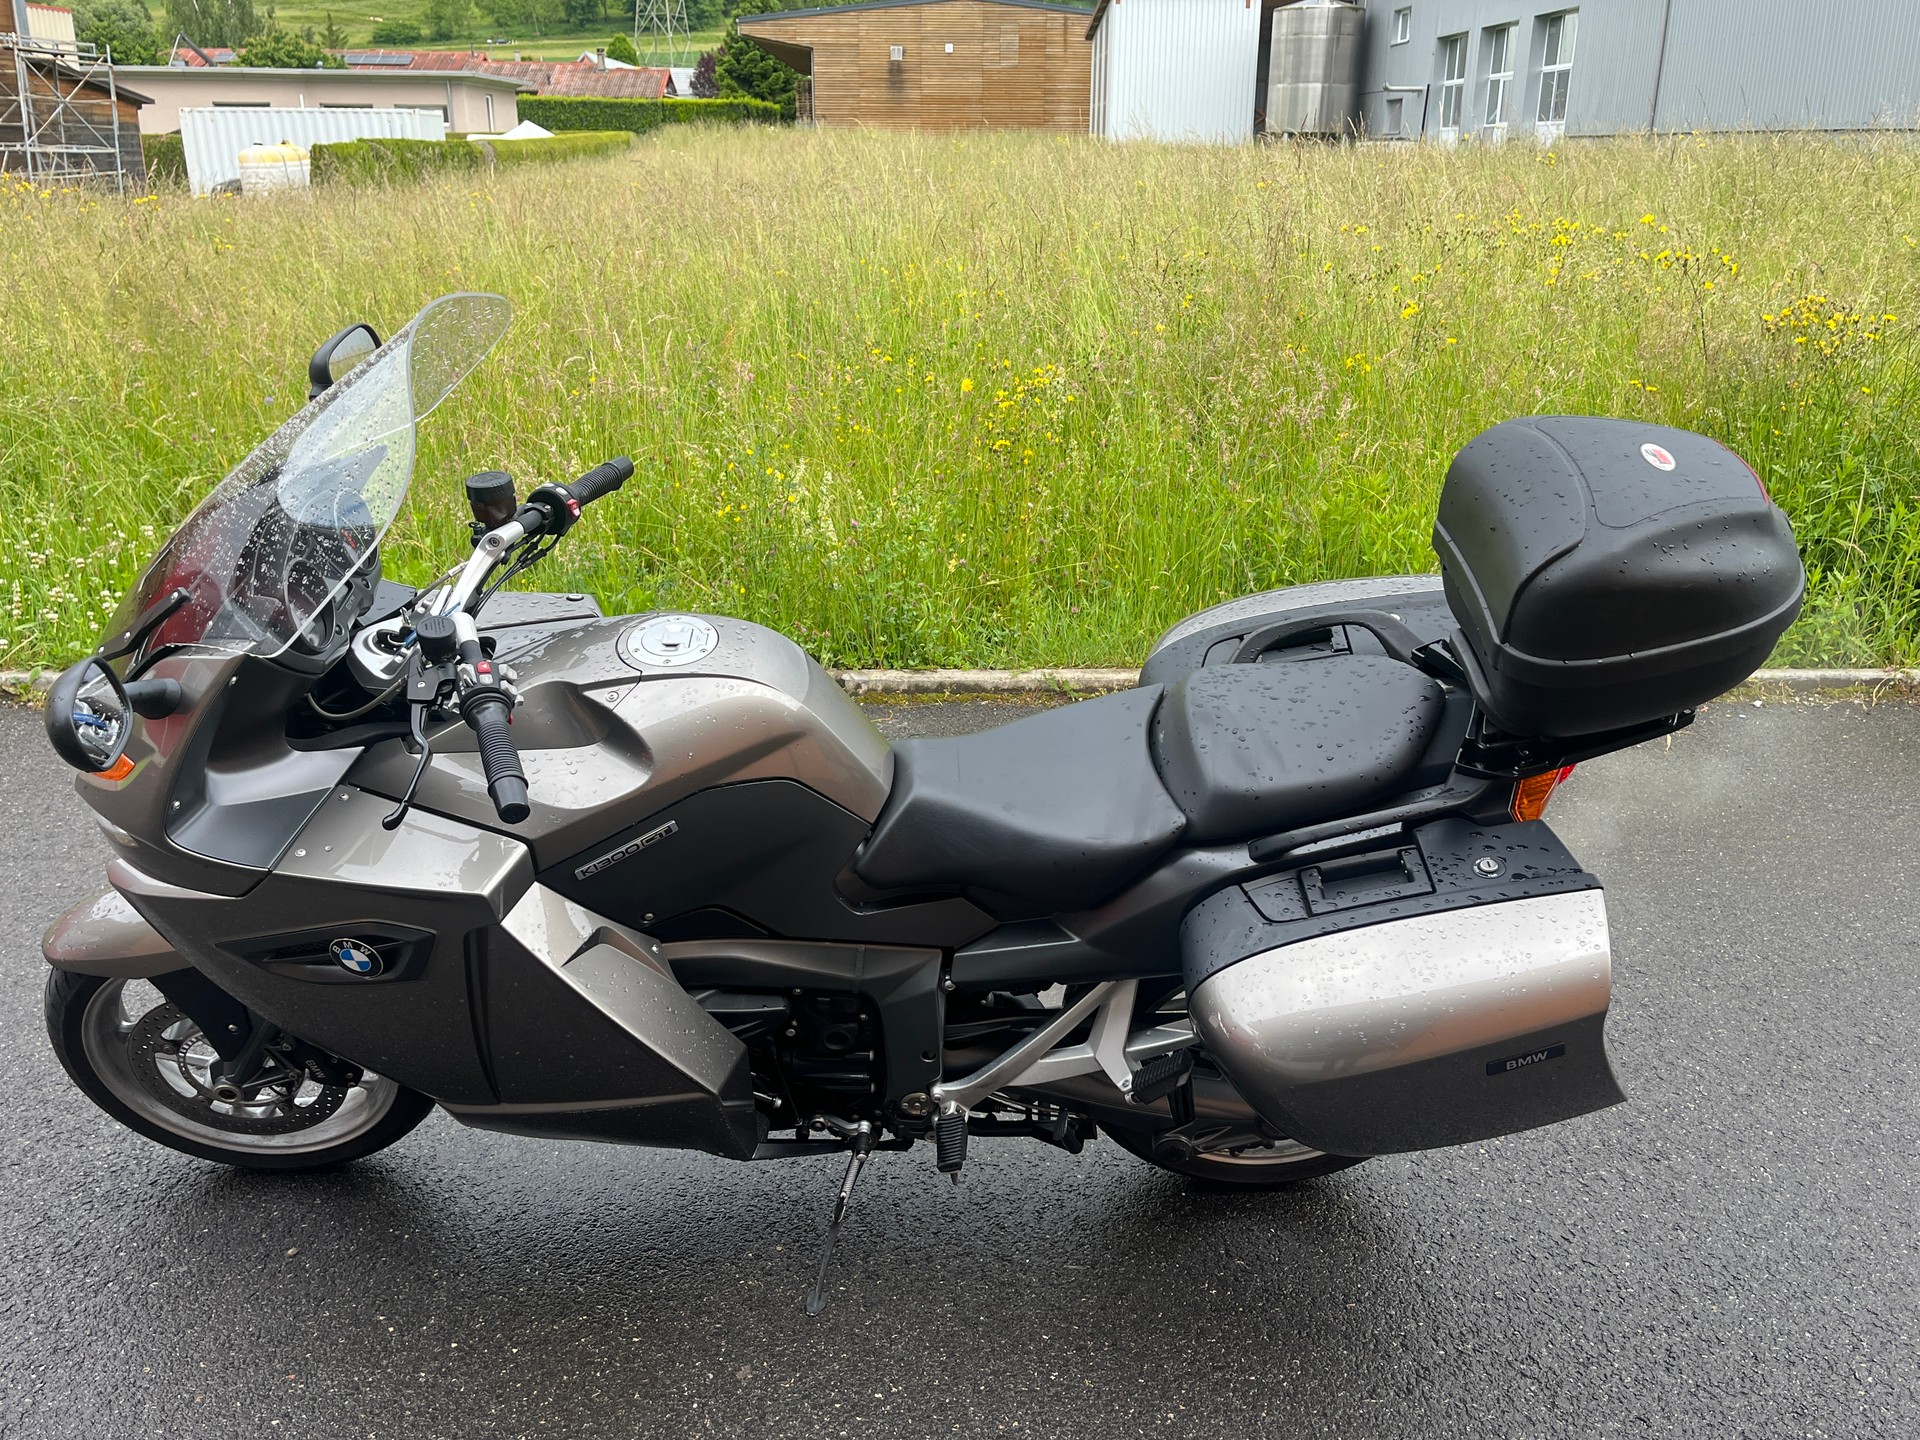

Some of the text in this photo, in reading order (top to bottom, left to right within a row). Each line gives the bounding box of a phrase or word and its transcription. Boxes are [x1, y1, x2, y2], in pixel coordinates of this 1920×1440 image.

[331, 940, 372, 956] BMW
[305, 1059, 327, 1078] BMW
[1506, 1050, 1548, 1071] BMW
